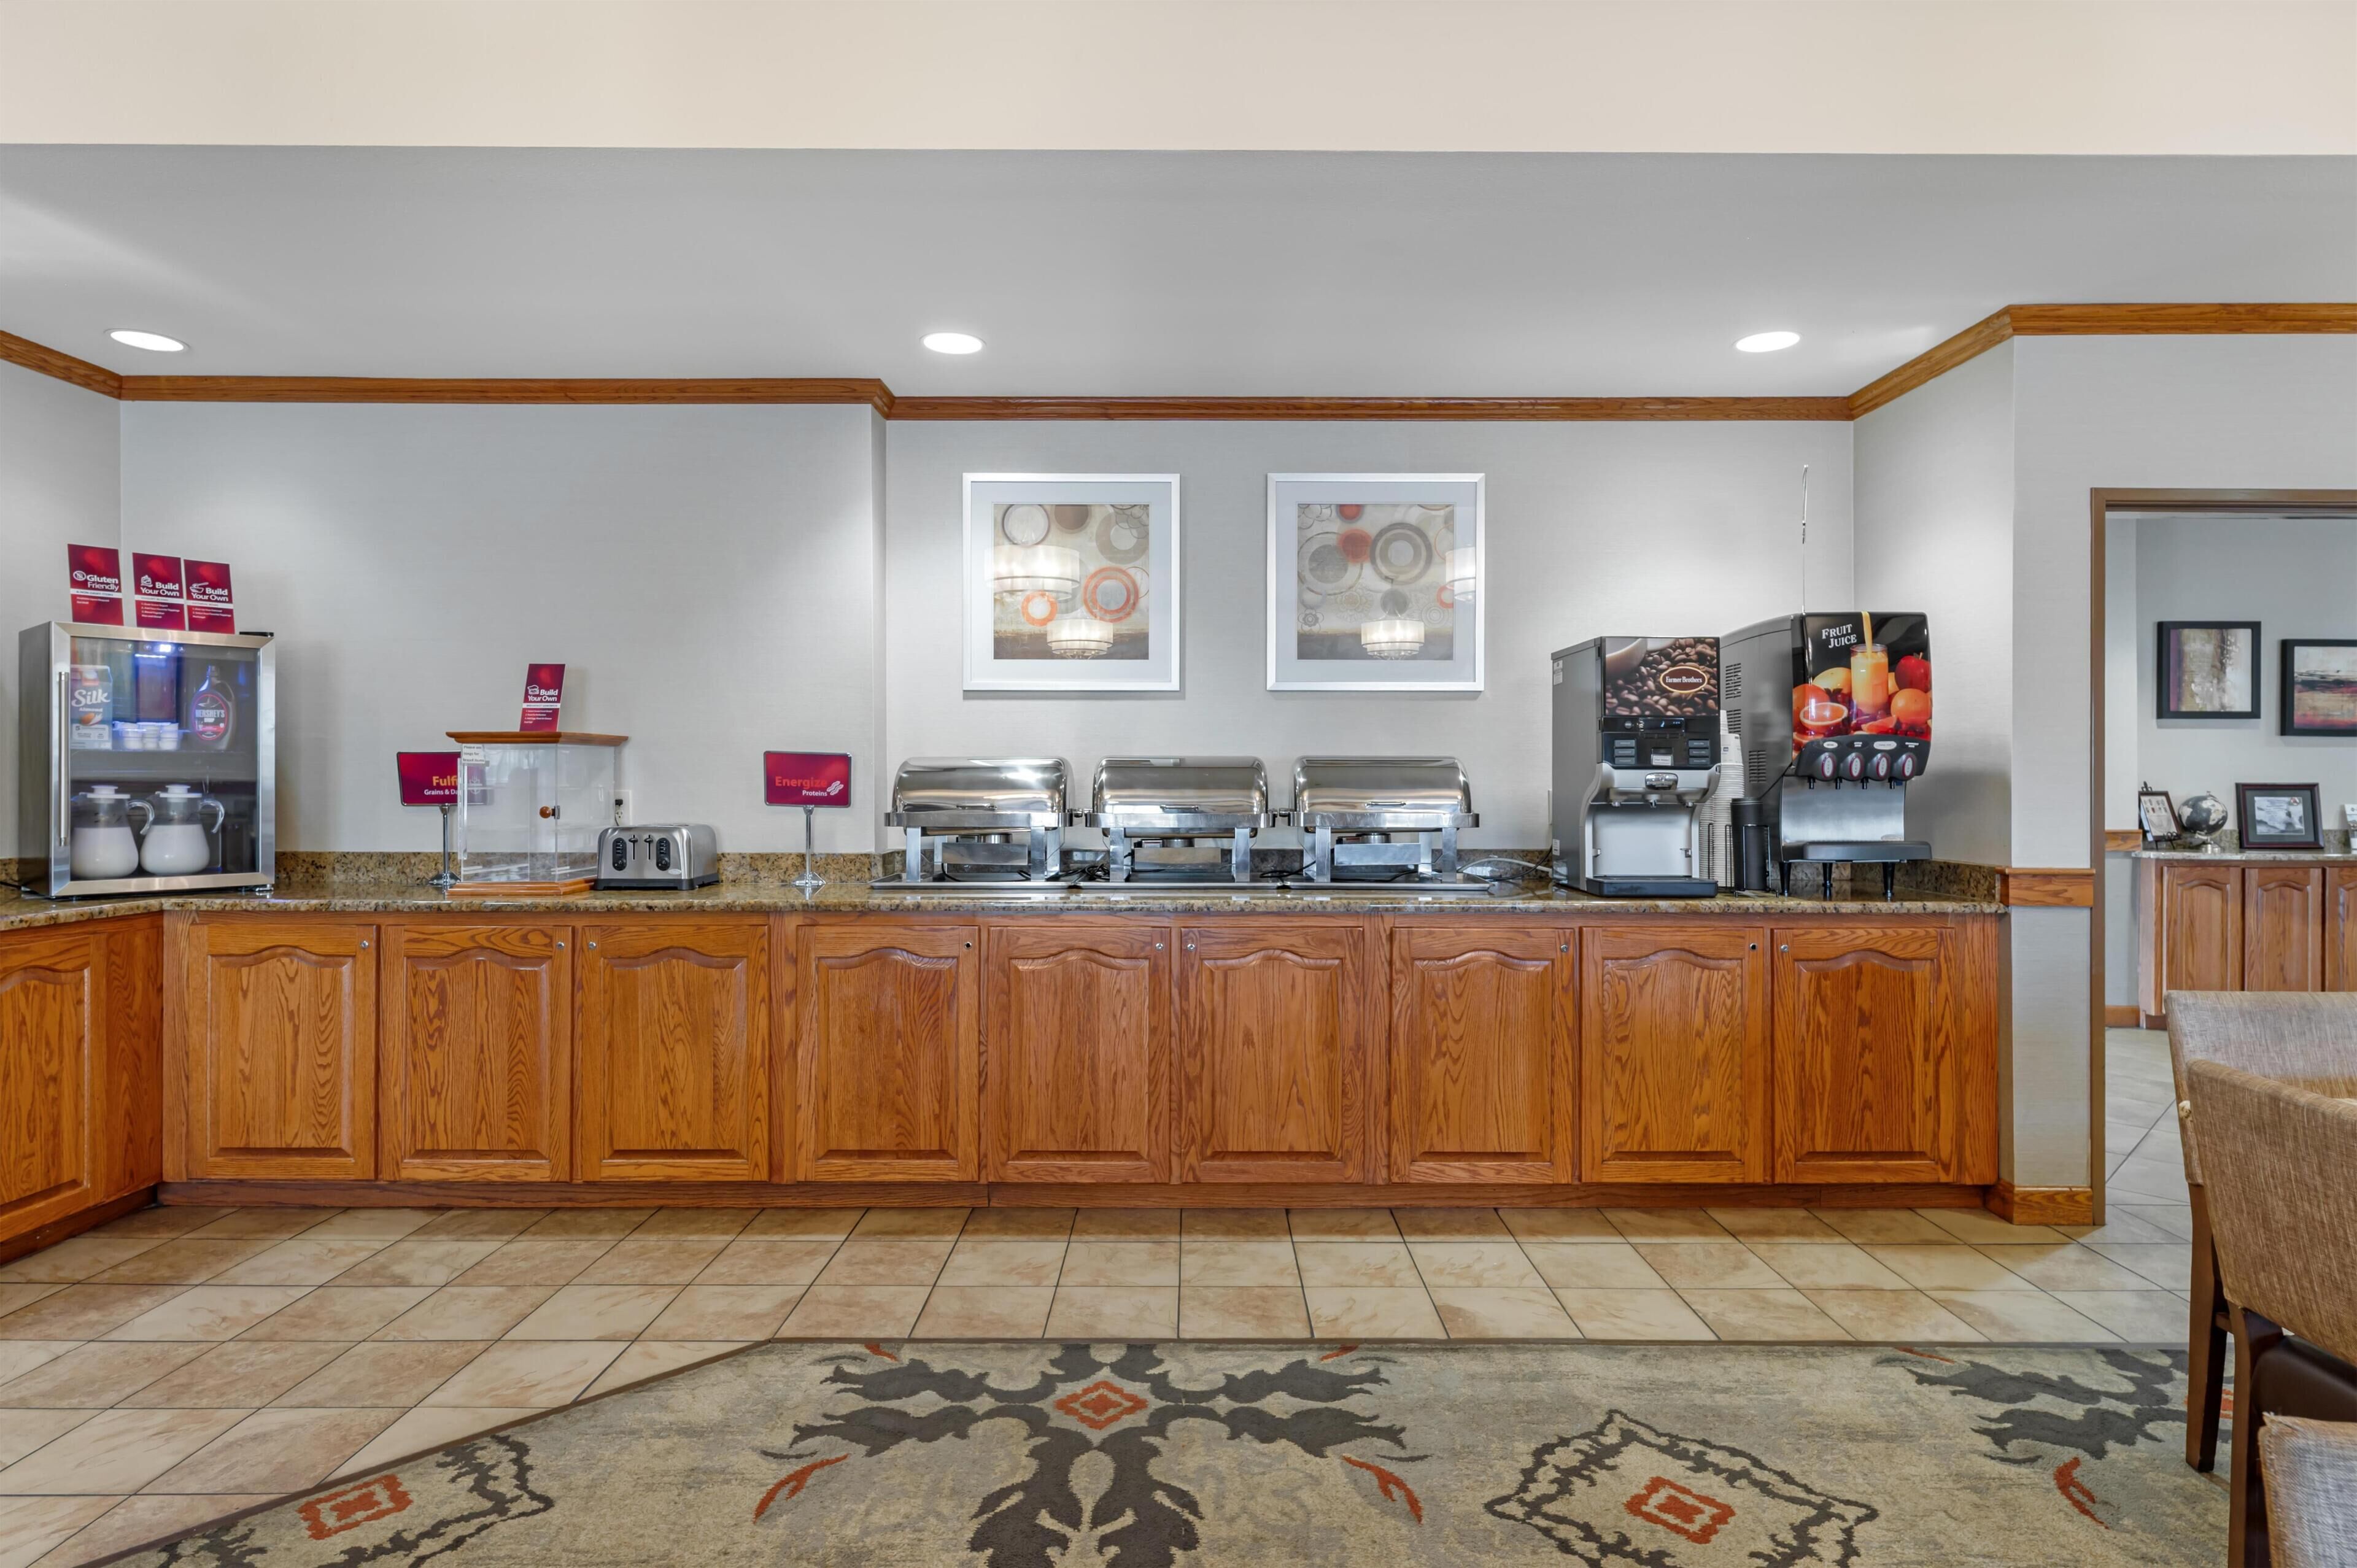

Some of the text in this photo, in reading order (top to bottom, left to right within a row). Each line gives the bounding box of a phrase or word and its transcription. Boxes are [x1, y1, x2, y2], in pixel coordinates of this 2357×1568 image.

[87, 574, 118, 584] Gluten
[88, 582, 119, 592] Friendly
[155, 582, 179, 590] Build
[1822, 624, 1852, 639] FRUIT
[1829, 634, 1857, 648] JUICE
[71, 689, 110, 707] Silk
[432, 775, 458, 786] Fulfi
[775, 776, 827, 790] Energize
